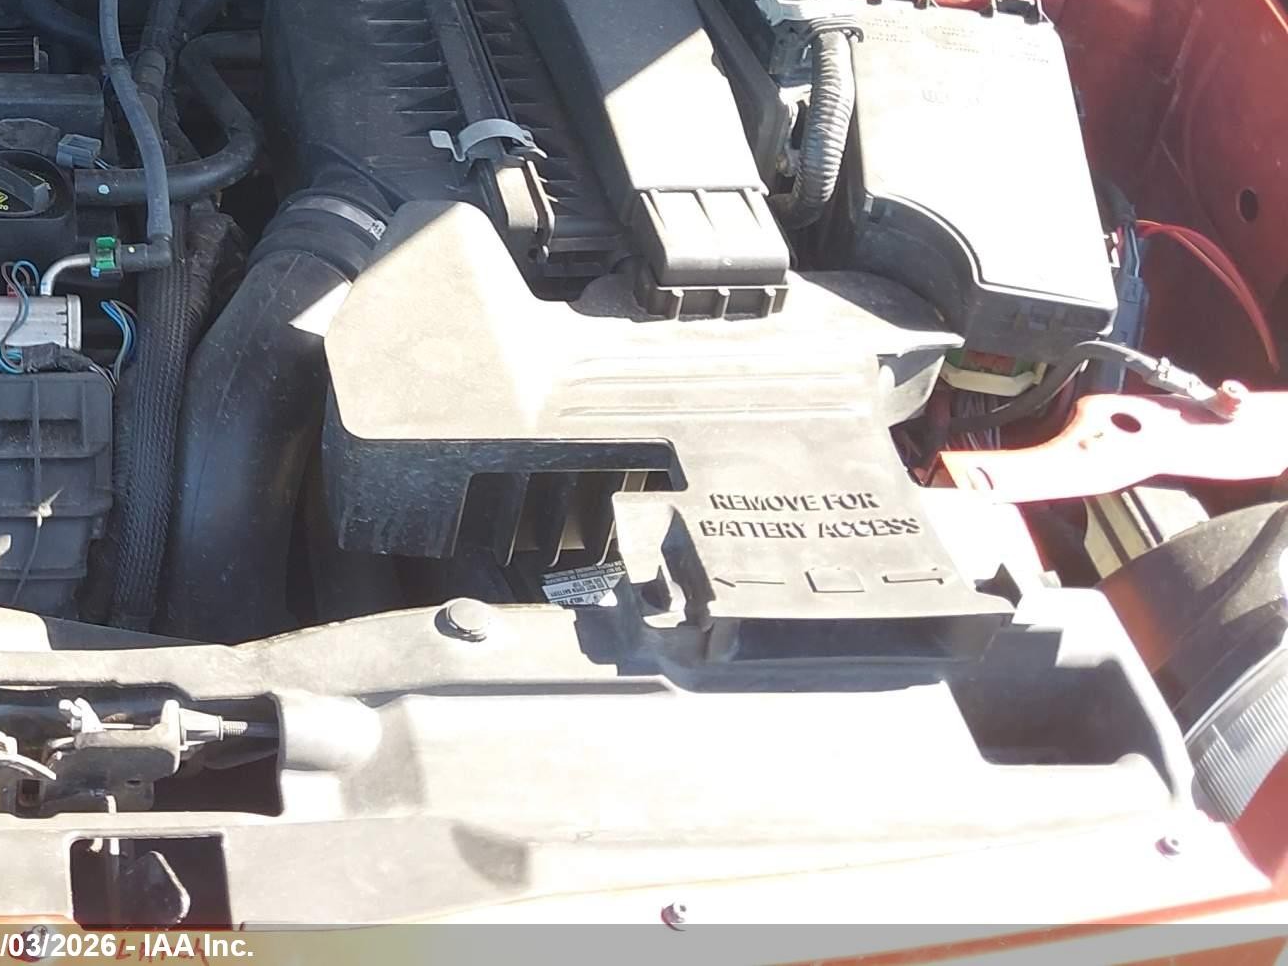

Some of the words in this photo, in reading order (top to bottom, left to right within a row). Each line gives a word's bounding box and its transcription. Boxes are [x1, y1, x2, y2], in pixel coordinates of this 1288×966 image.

[710, 493, 821, 511] REMOVE
[822, 492, 880, 510] FOR
[699, 519, 808, 539] BATTERY
[818, 518, 920, 539] ACCESS
